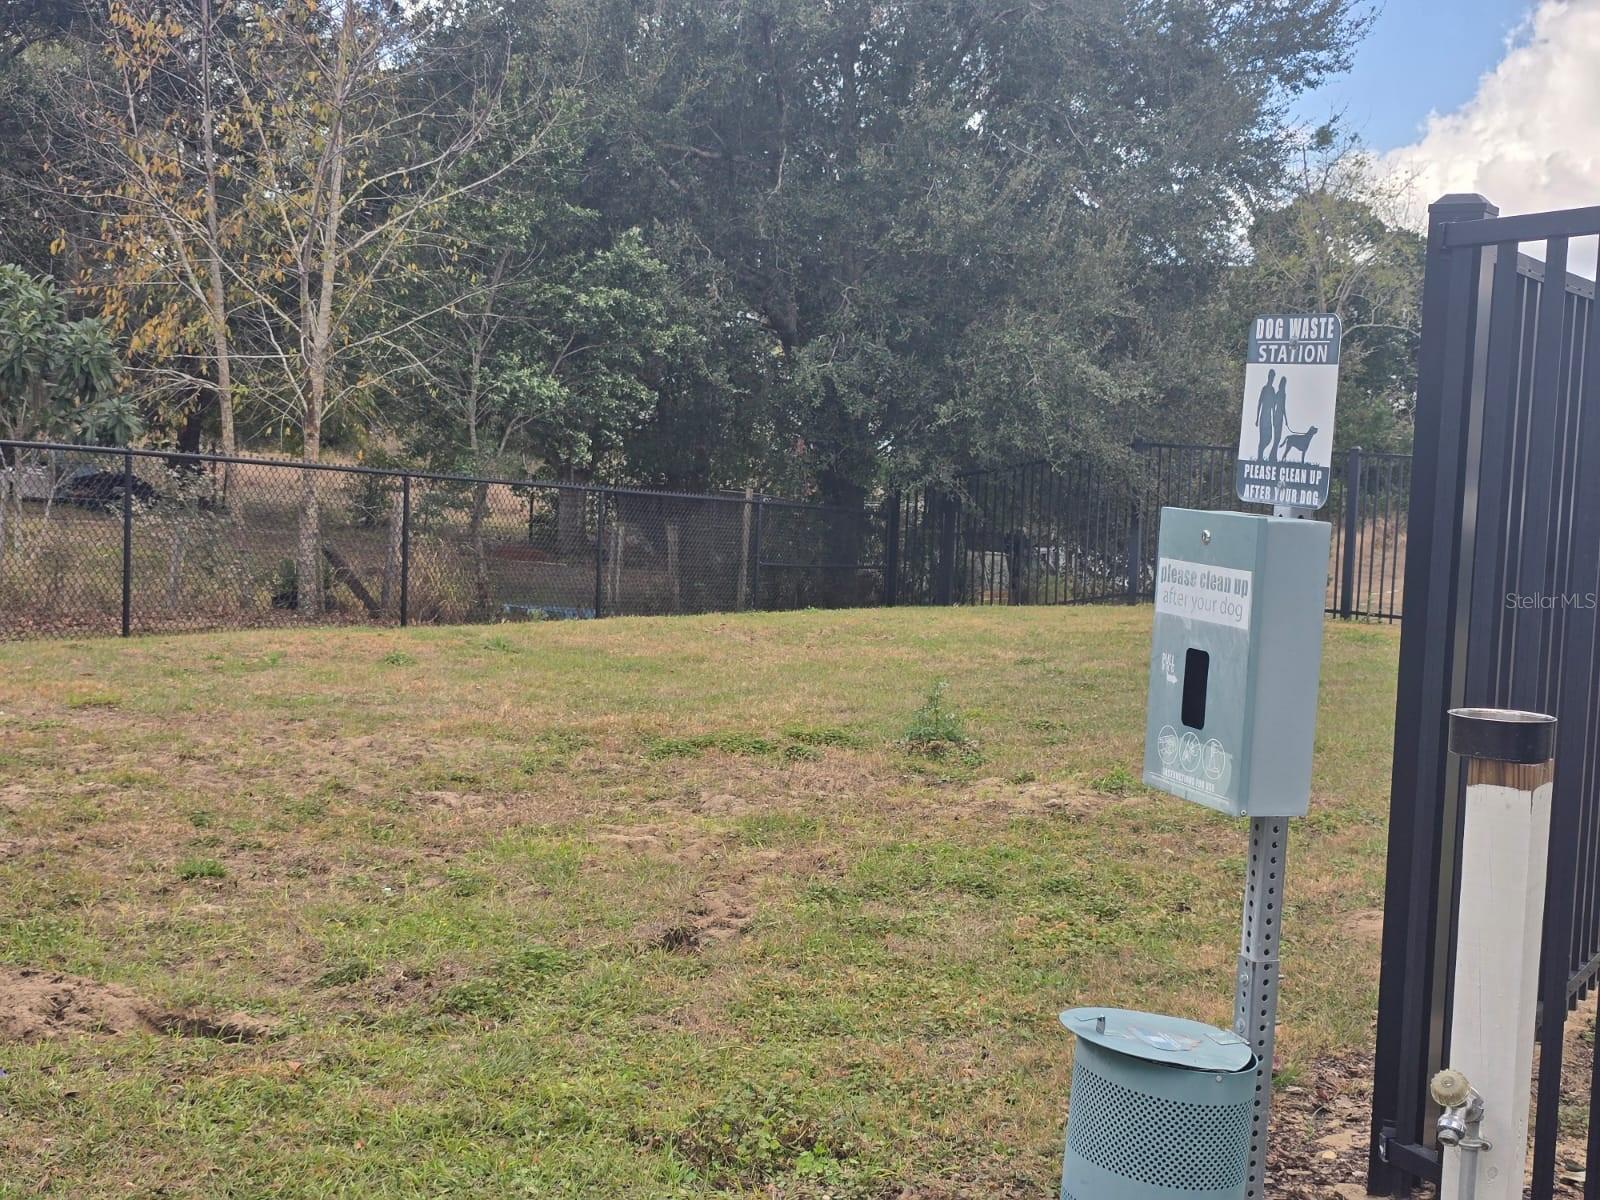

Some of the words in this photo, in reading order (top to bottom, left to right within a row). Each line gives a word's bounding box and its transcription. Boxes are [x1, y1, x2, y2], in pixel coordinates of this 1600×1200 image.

[1255, 318, 1284, 339] DOG
[1289, 317, 1335, 339] WASTE
[1258, 344, 1328, 363] STATION
[1243, 463, 1277, 481] PLEASE
[1280, 466, 1307, 484] CLEAN
[1309, 469, 1322, 485] UP
[1243, 484, 1271, 500] AFTER
[1274, 486, 1298, 504] YOUR
[1300, 489, 1319, 506] DOG
[1160, 563, 1197, 587] please
[1199, 570, 1232, 593] clean
[1233, 578, 1249, 598] up
[1163, 585, 1188, 609] after
[1191, 596, 1217, 614] your
[1220, 596, 1243, 622] dog
